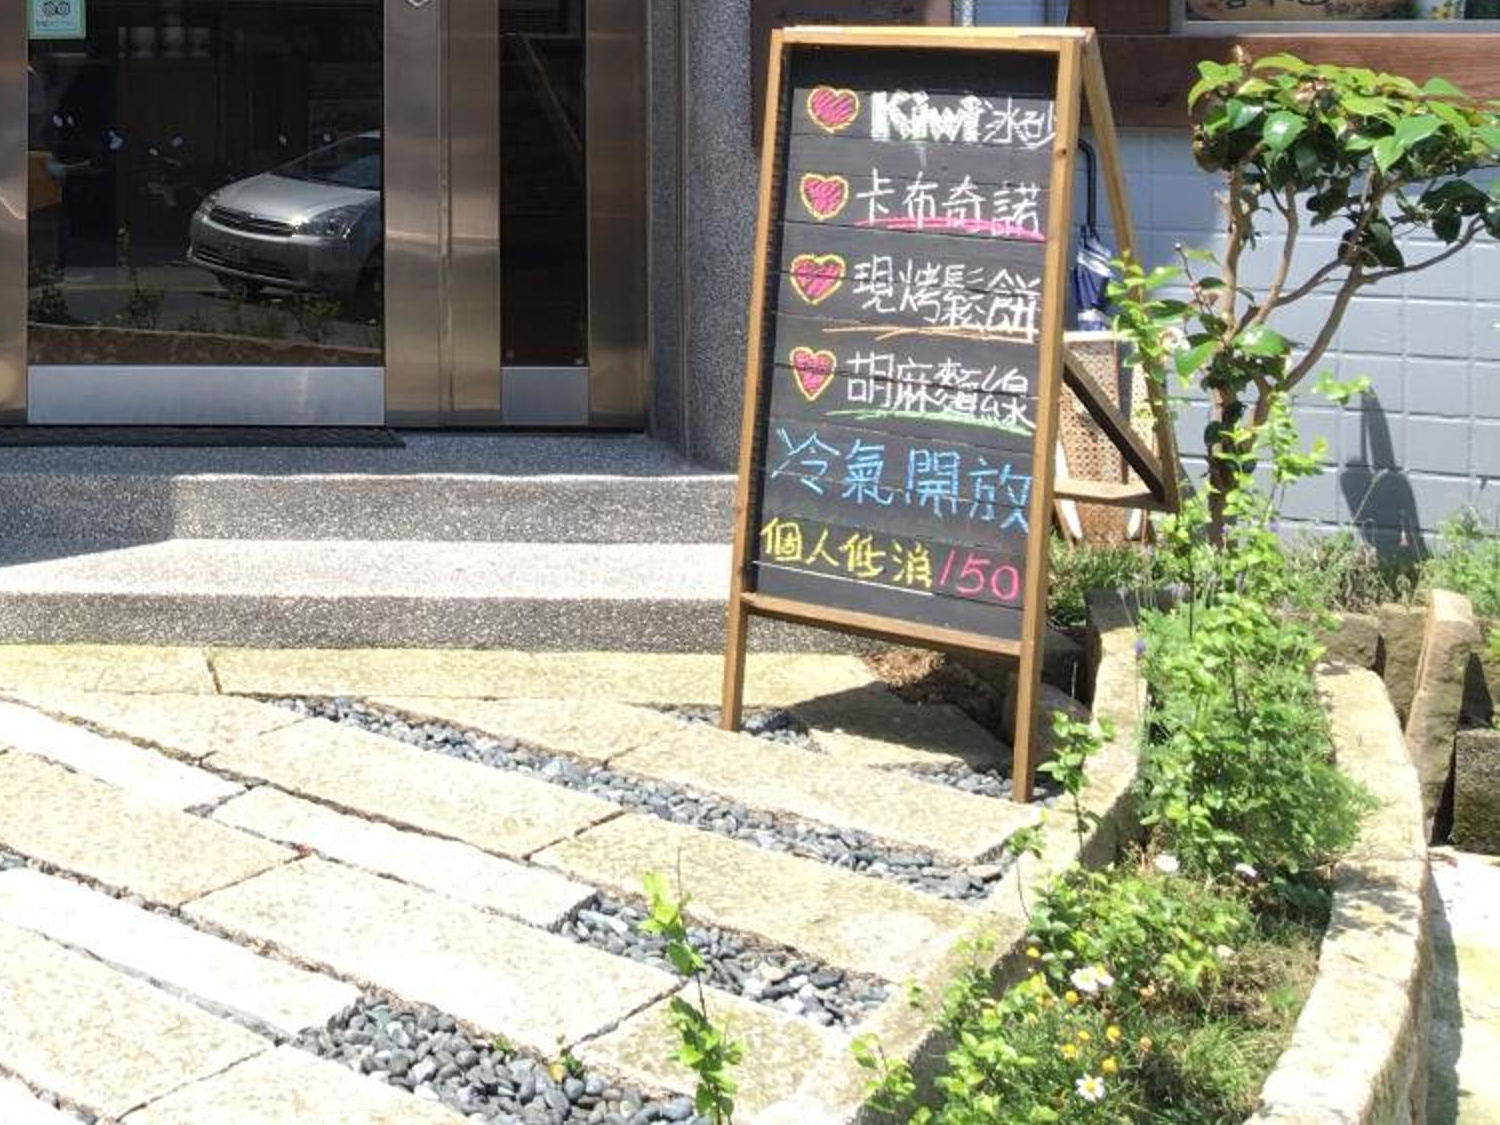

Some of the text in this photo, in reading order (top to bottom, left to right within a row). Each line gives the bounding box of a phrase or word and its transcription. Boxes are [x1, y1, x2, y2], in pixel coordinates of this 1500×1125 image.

[856, 168, 1042, 236] 卡布奇諾
[853, 254, 1041, 343] 現烤鬆餅
[846, 351, 1038, 428] 胡麻麵線
[770, 427, 1033, 533] 冷氣開放
